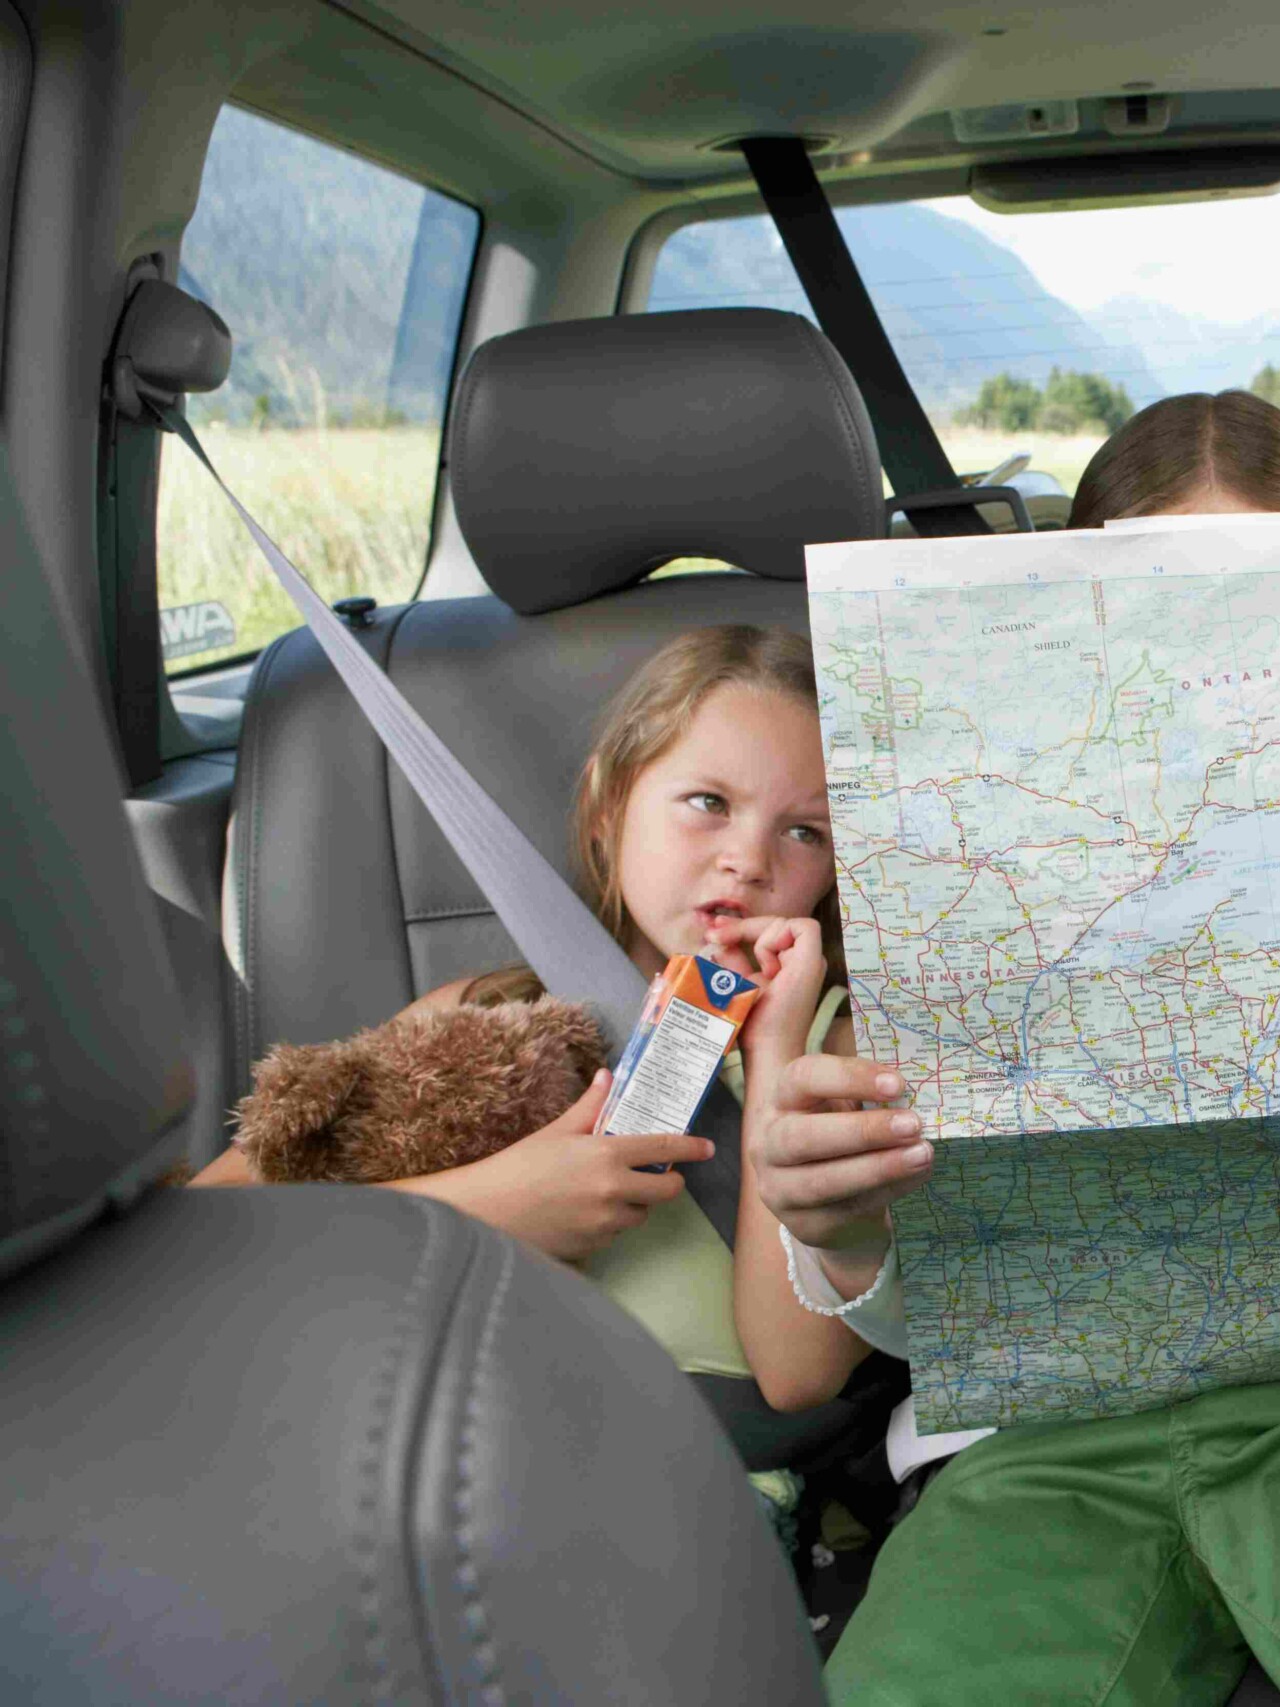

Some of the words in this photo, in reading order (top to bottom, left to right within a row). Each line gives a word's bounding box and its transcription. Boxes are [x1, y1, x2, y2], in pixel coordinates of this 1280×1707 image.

[1152, 566, 1163, 574] 14
[894, 578, 905, 586] 12
[981, 621, 1036, 636] CANADIAN
[1034, 639, 1071, 651] SHIELD
[827, 781, 861, 794] NNIPEG
[1170, 840, 1198, 849] Thunder
[900, 968, 1015, 985] MINNESOTA
[965, 1071, 1015, 1081] MINNEAPOLIS
[1105, 1061, 1209, 1082] WISCONSIN
[1077, 1080, 1099, 1088] CLAIRE
[968, 1086, 1015, 1095] BLOOMINGTON
[1200, 1090, 1233, 1099] APPLETON
[1198, 1102, 1230, 1112] OSHKOSH
